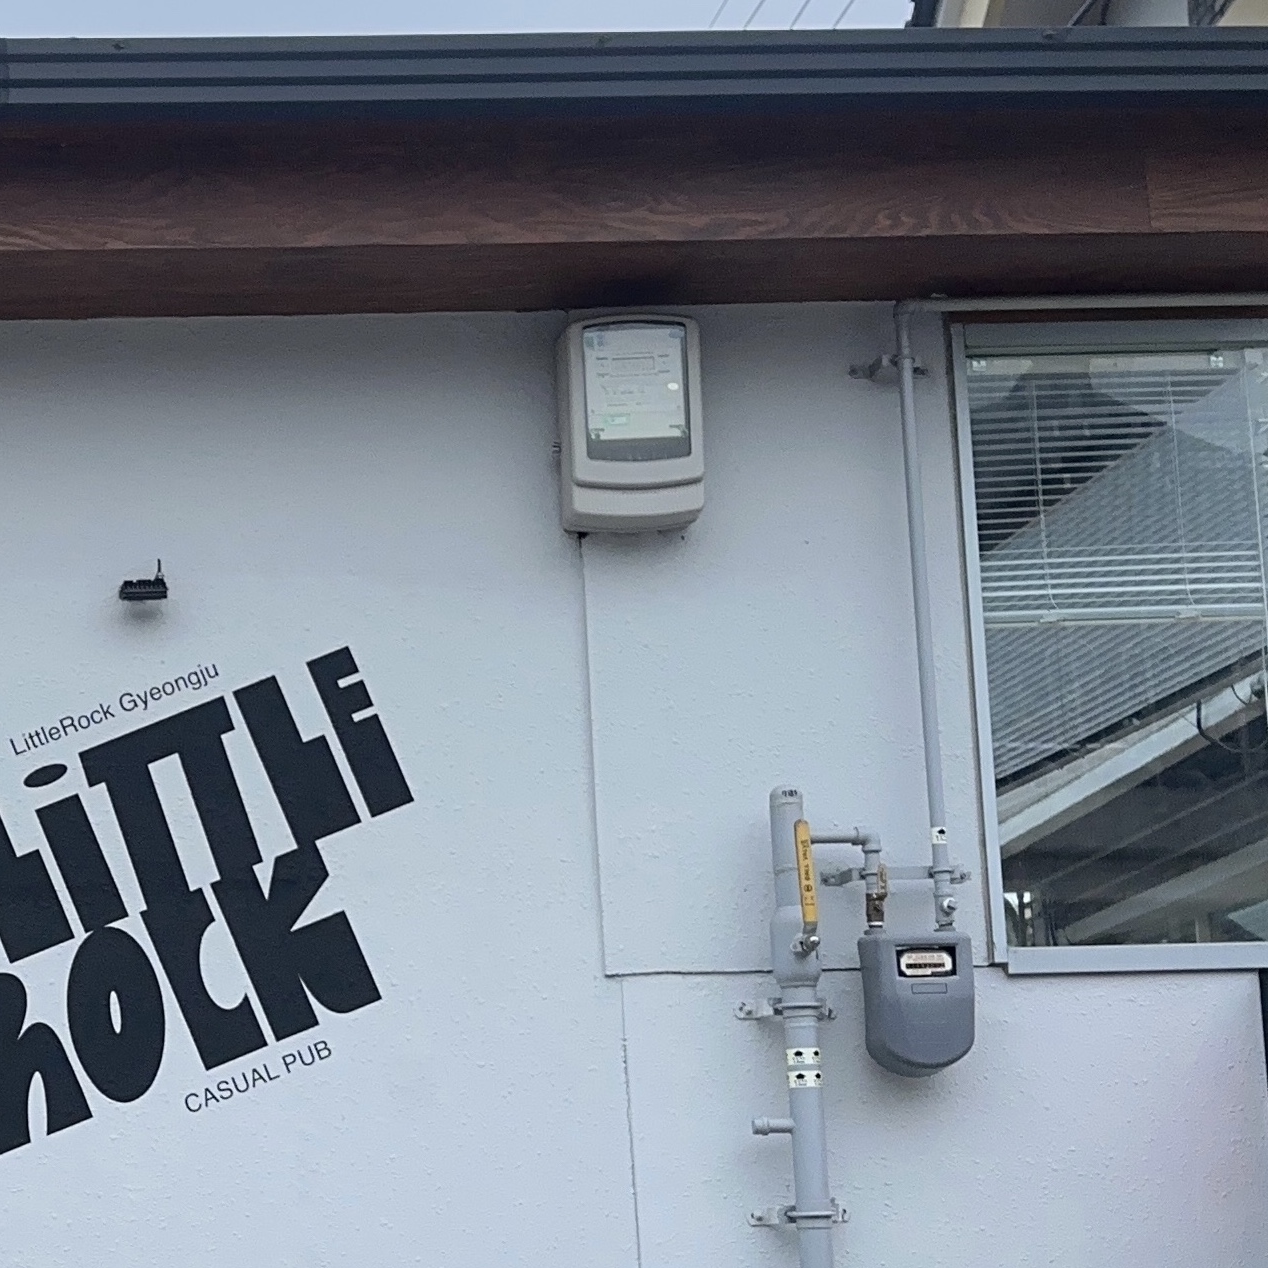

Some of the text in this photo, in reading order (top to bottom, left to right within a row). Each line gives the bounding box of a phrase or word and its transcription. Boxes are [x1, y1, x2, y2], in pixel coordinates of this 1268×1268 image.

[10, 663, 219, 755] LittleRock Gyeongju
[184, 1040, 332, 1113] CASUAL PUB
